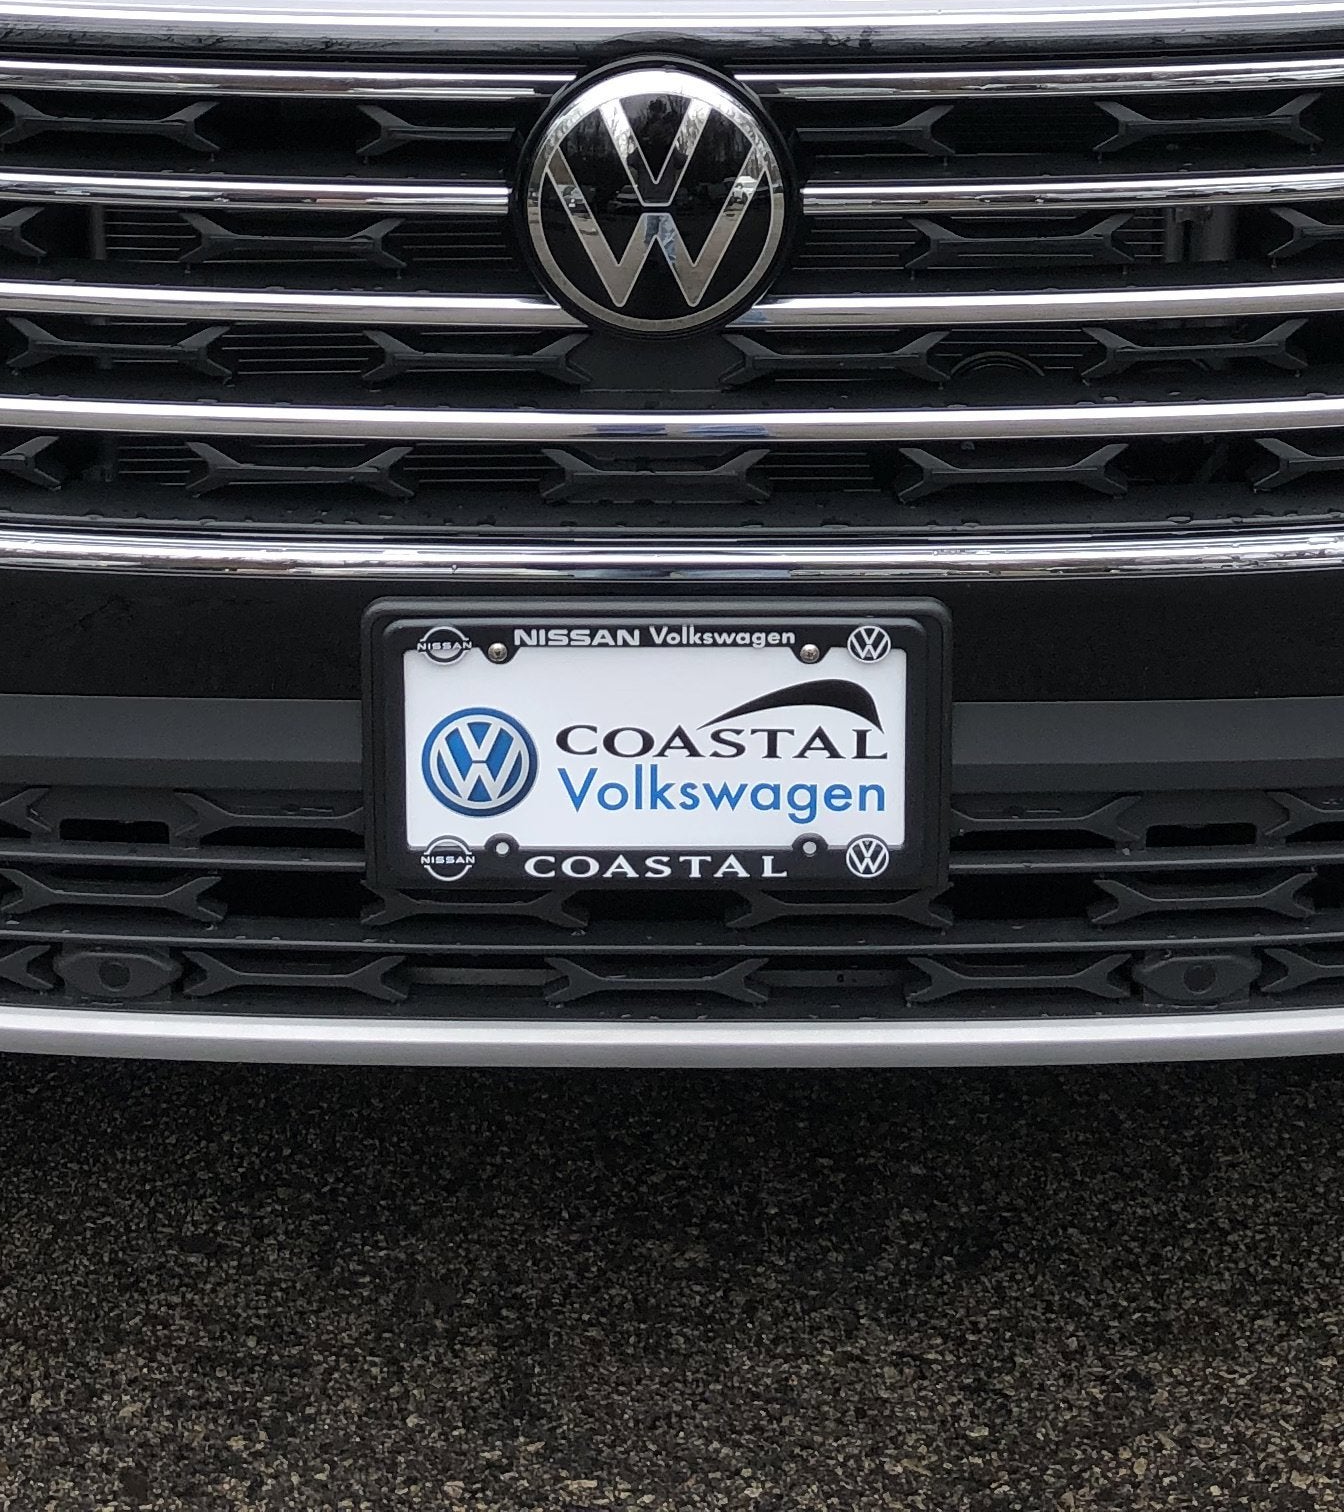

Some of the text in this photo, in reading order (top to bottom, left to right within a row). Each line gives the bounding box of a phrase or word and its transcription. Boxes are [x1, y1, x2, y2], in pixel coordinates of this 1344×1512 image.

[417, 640, 473, 651] NISSAN
[514, 624, 796, 648] NISSAN Volkswagen
[555, 724, 888, 760] COASTAL
[557, 763, 886, 825] Volkswagen
[420, 855, 476, 865] NISSAN
[524, 854, 788, 879] COASTAL
